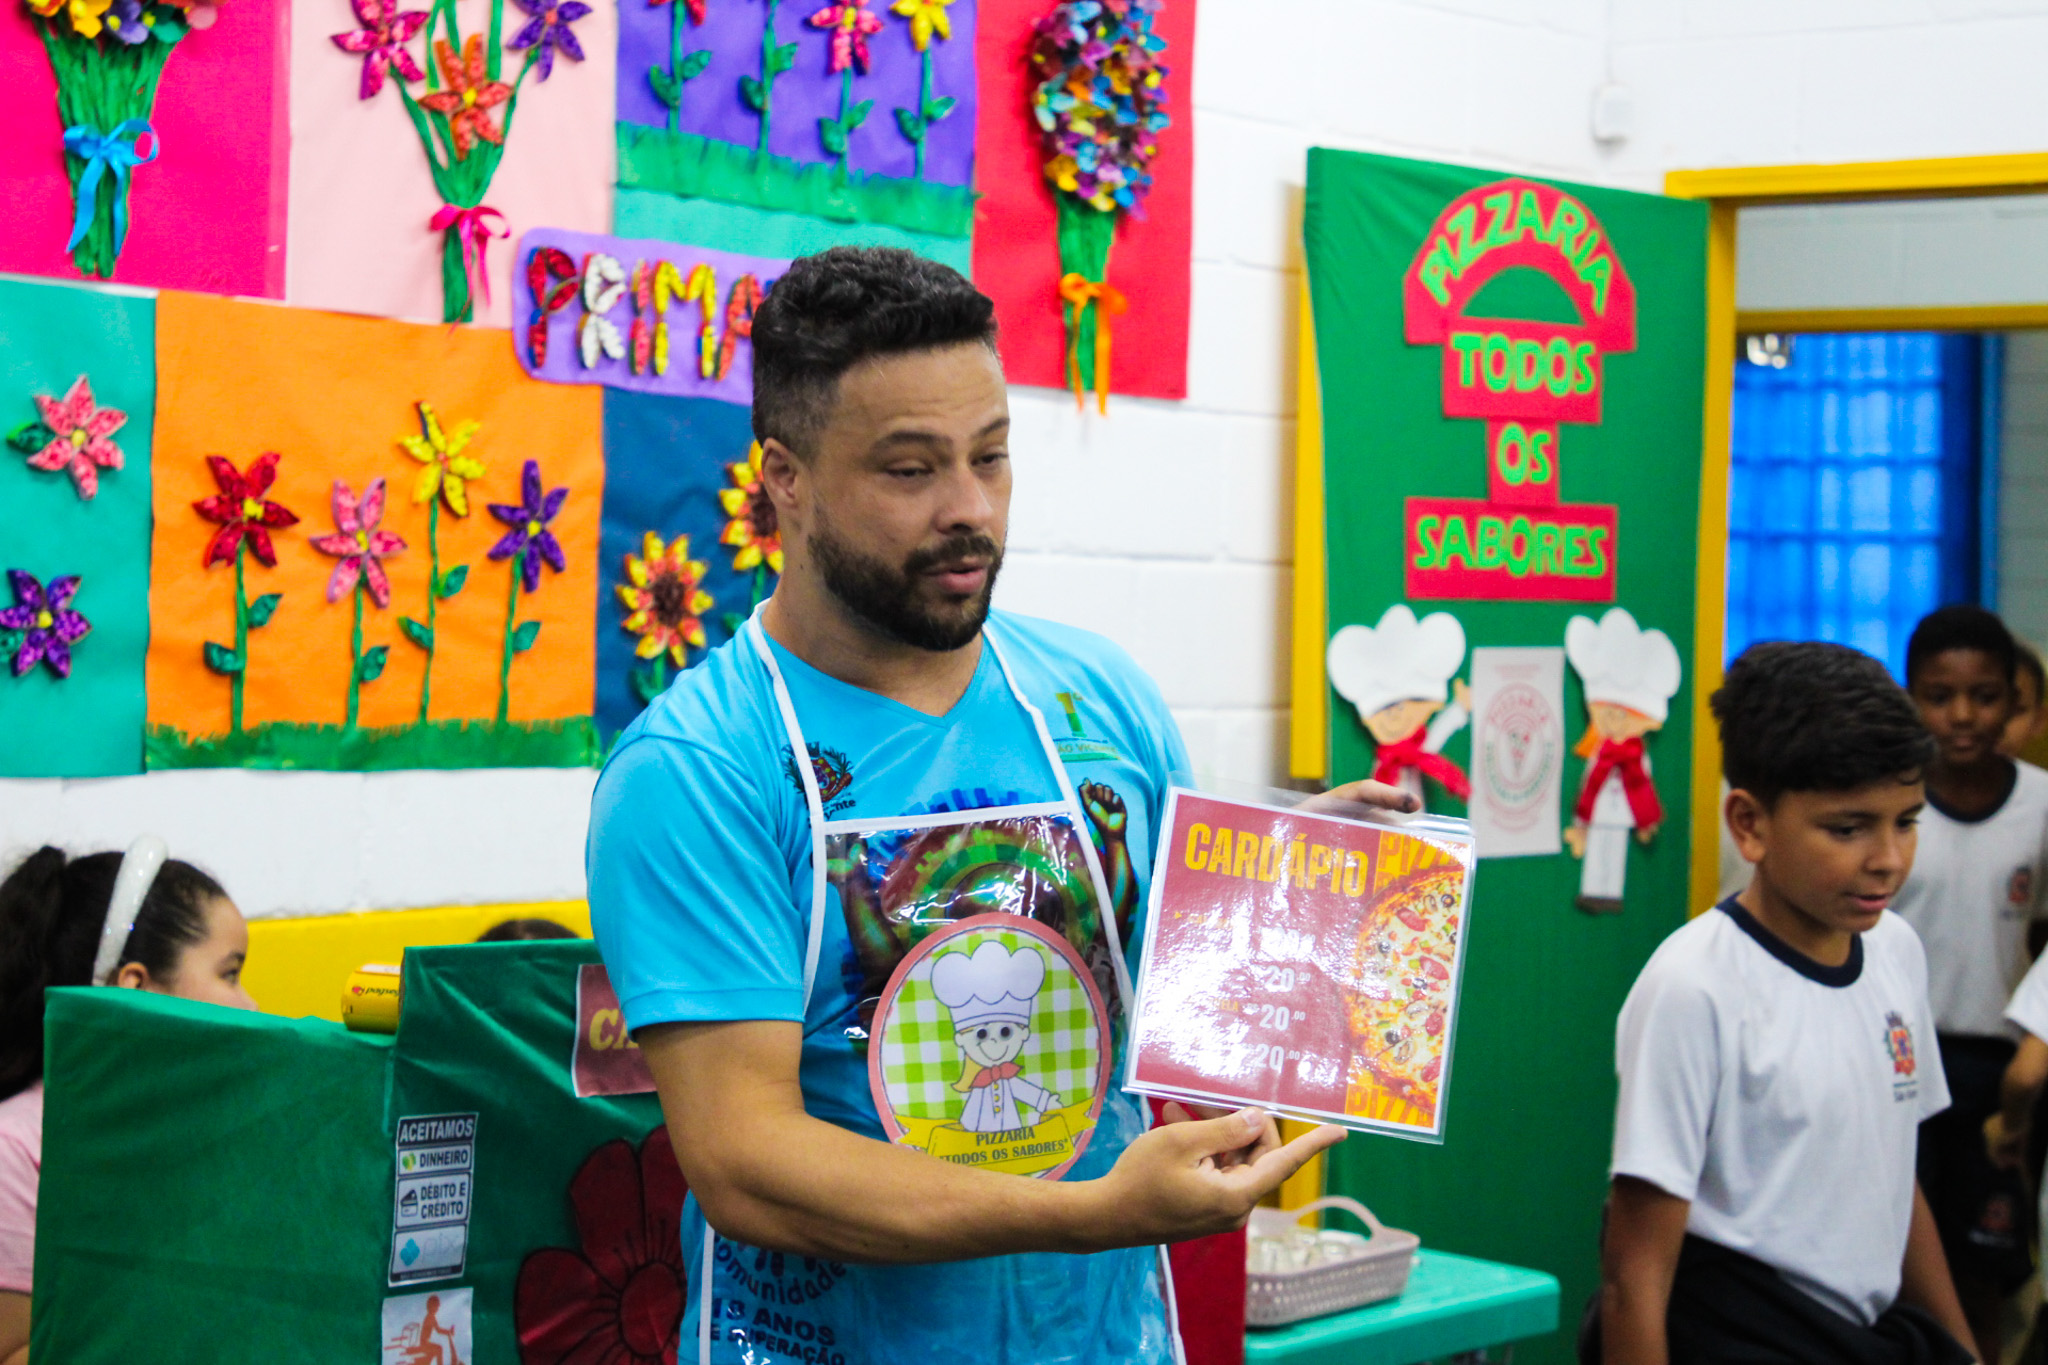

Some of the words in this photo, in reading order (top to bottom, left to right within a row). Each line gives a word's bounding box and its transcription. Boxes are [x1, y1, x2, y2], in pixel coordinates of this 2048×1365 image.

[1419, 190, 1613, 316] PIZZARIA
[1451, 331, 1597, 397] TODOS
[1496, 421, 1552, 486] OS
[1413, 513, 1609, 578] SABORES
[1184, 822, 1370, 898] CARDÁPIO
[400, 1118, 475, 1143] ACEITAMOS
[976, 1127, 1035, 1146] PIZZARIA
[420, 1149, 469, 1169] DINHEIRO
[991, 1148, 1008, 1160] OS
[421, 1181, 457, 1201] DÉBITO
[459, 1182, 467, 1197] E
[421, 1201, 464, 1219] CRÉDITO
[714, 1232, 847, 1305] omunidade
[752, 1307, 836, 1346] ANOS
